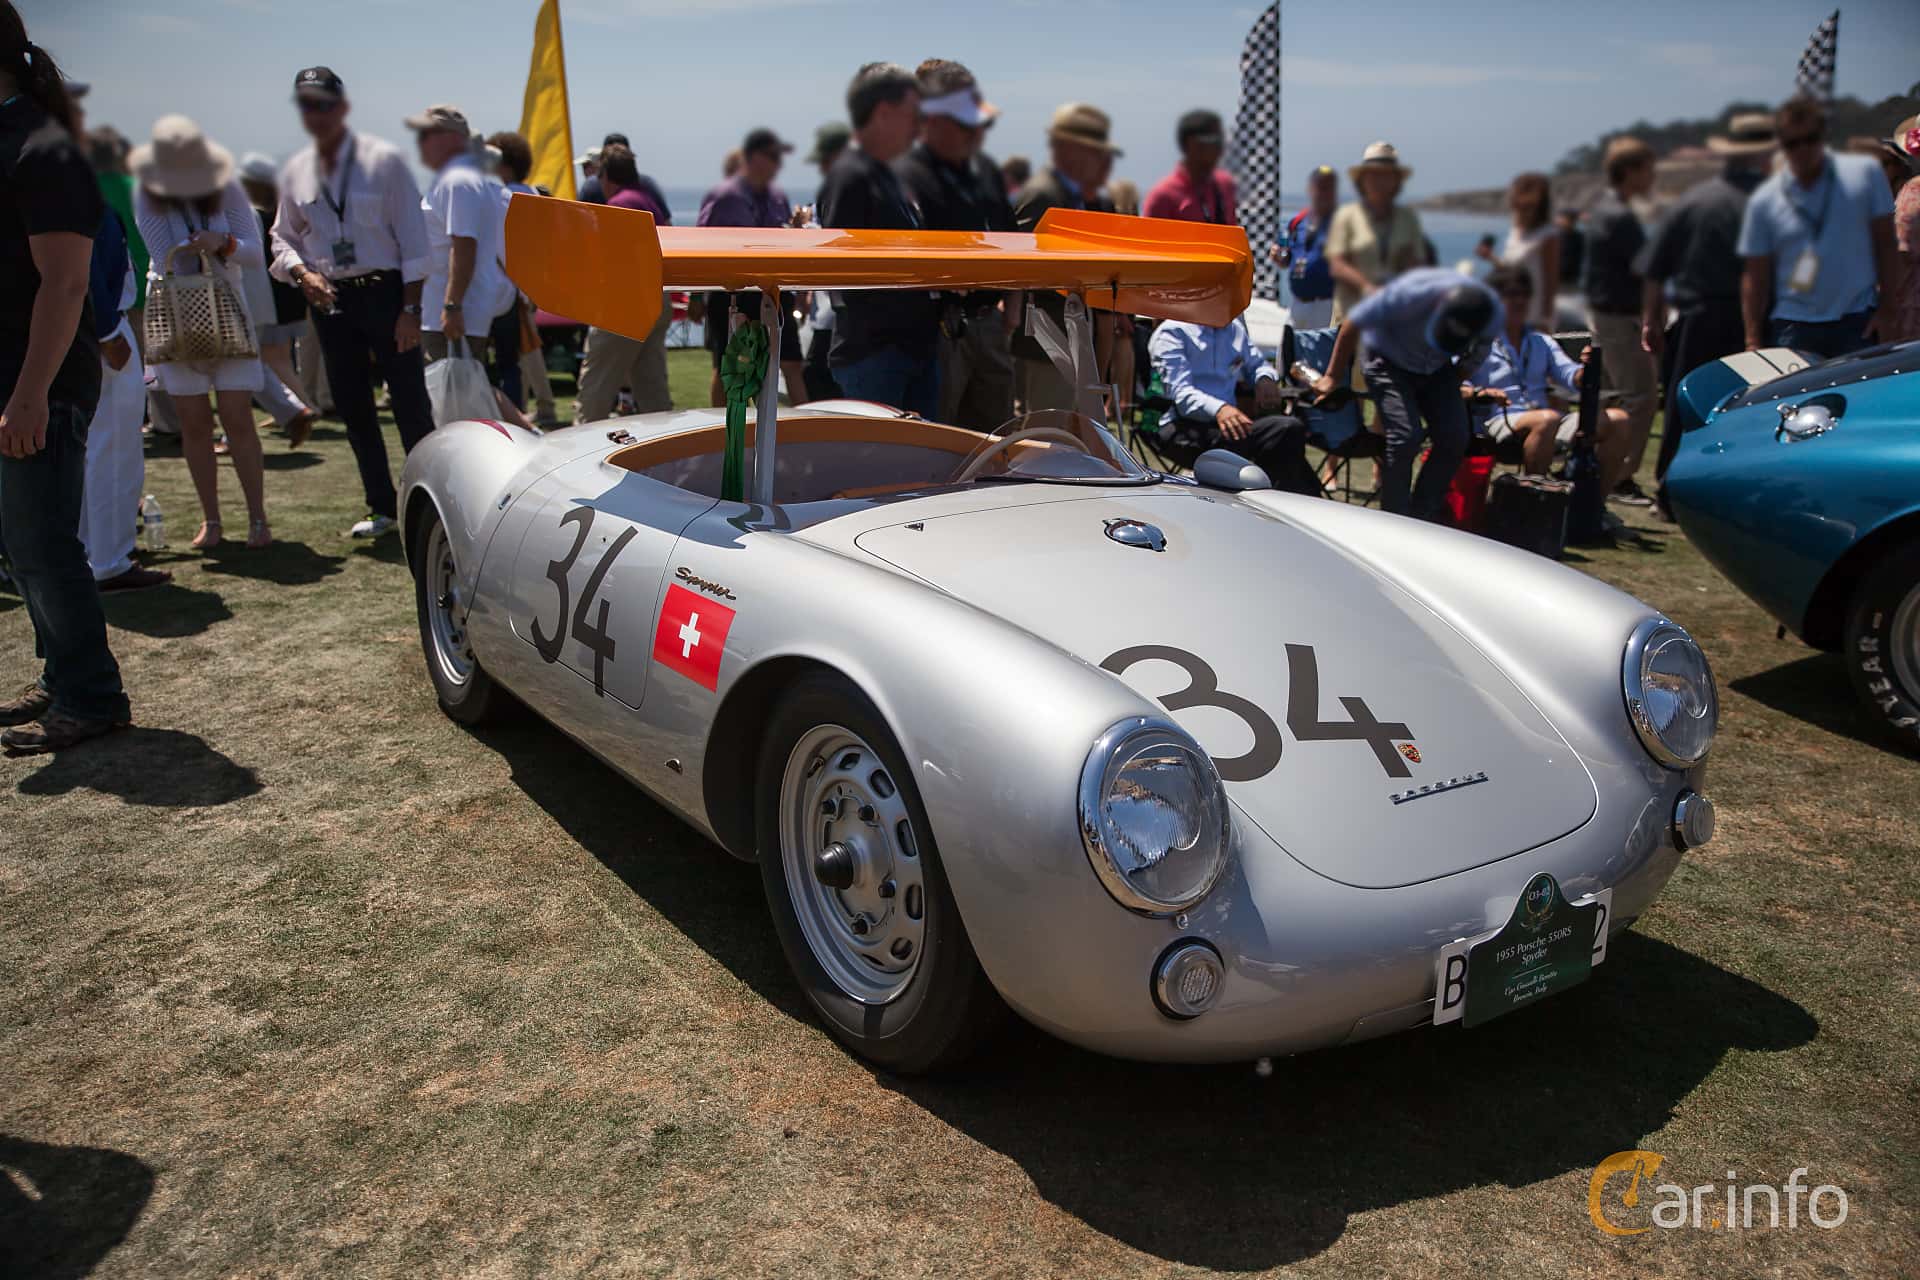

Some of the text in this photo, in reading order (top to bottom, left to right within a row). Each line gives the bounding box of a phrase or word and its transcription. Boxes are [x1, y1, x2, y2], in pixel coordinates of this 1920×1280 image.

[530, 505, 640, 699] 34
[1098, 643, 1416, 783] 34
[1442, 954, 1468, 1011] B
[1592, 904, 1607, 953] 2
[1496, 925, 1573, 963] 1955 Porsche 550RS
[1520, 947, 1548, 967] Spyder
